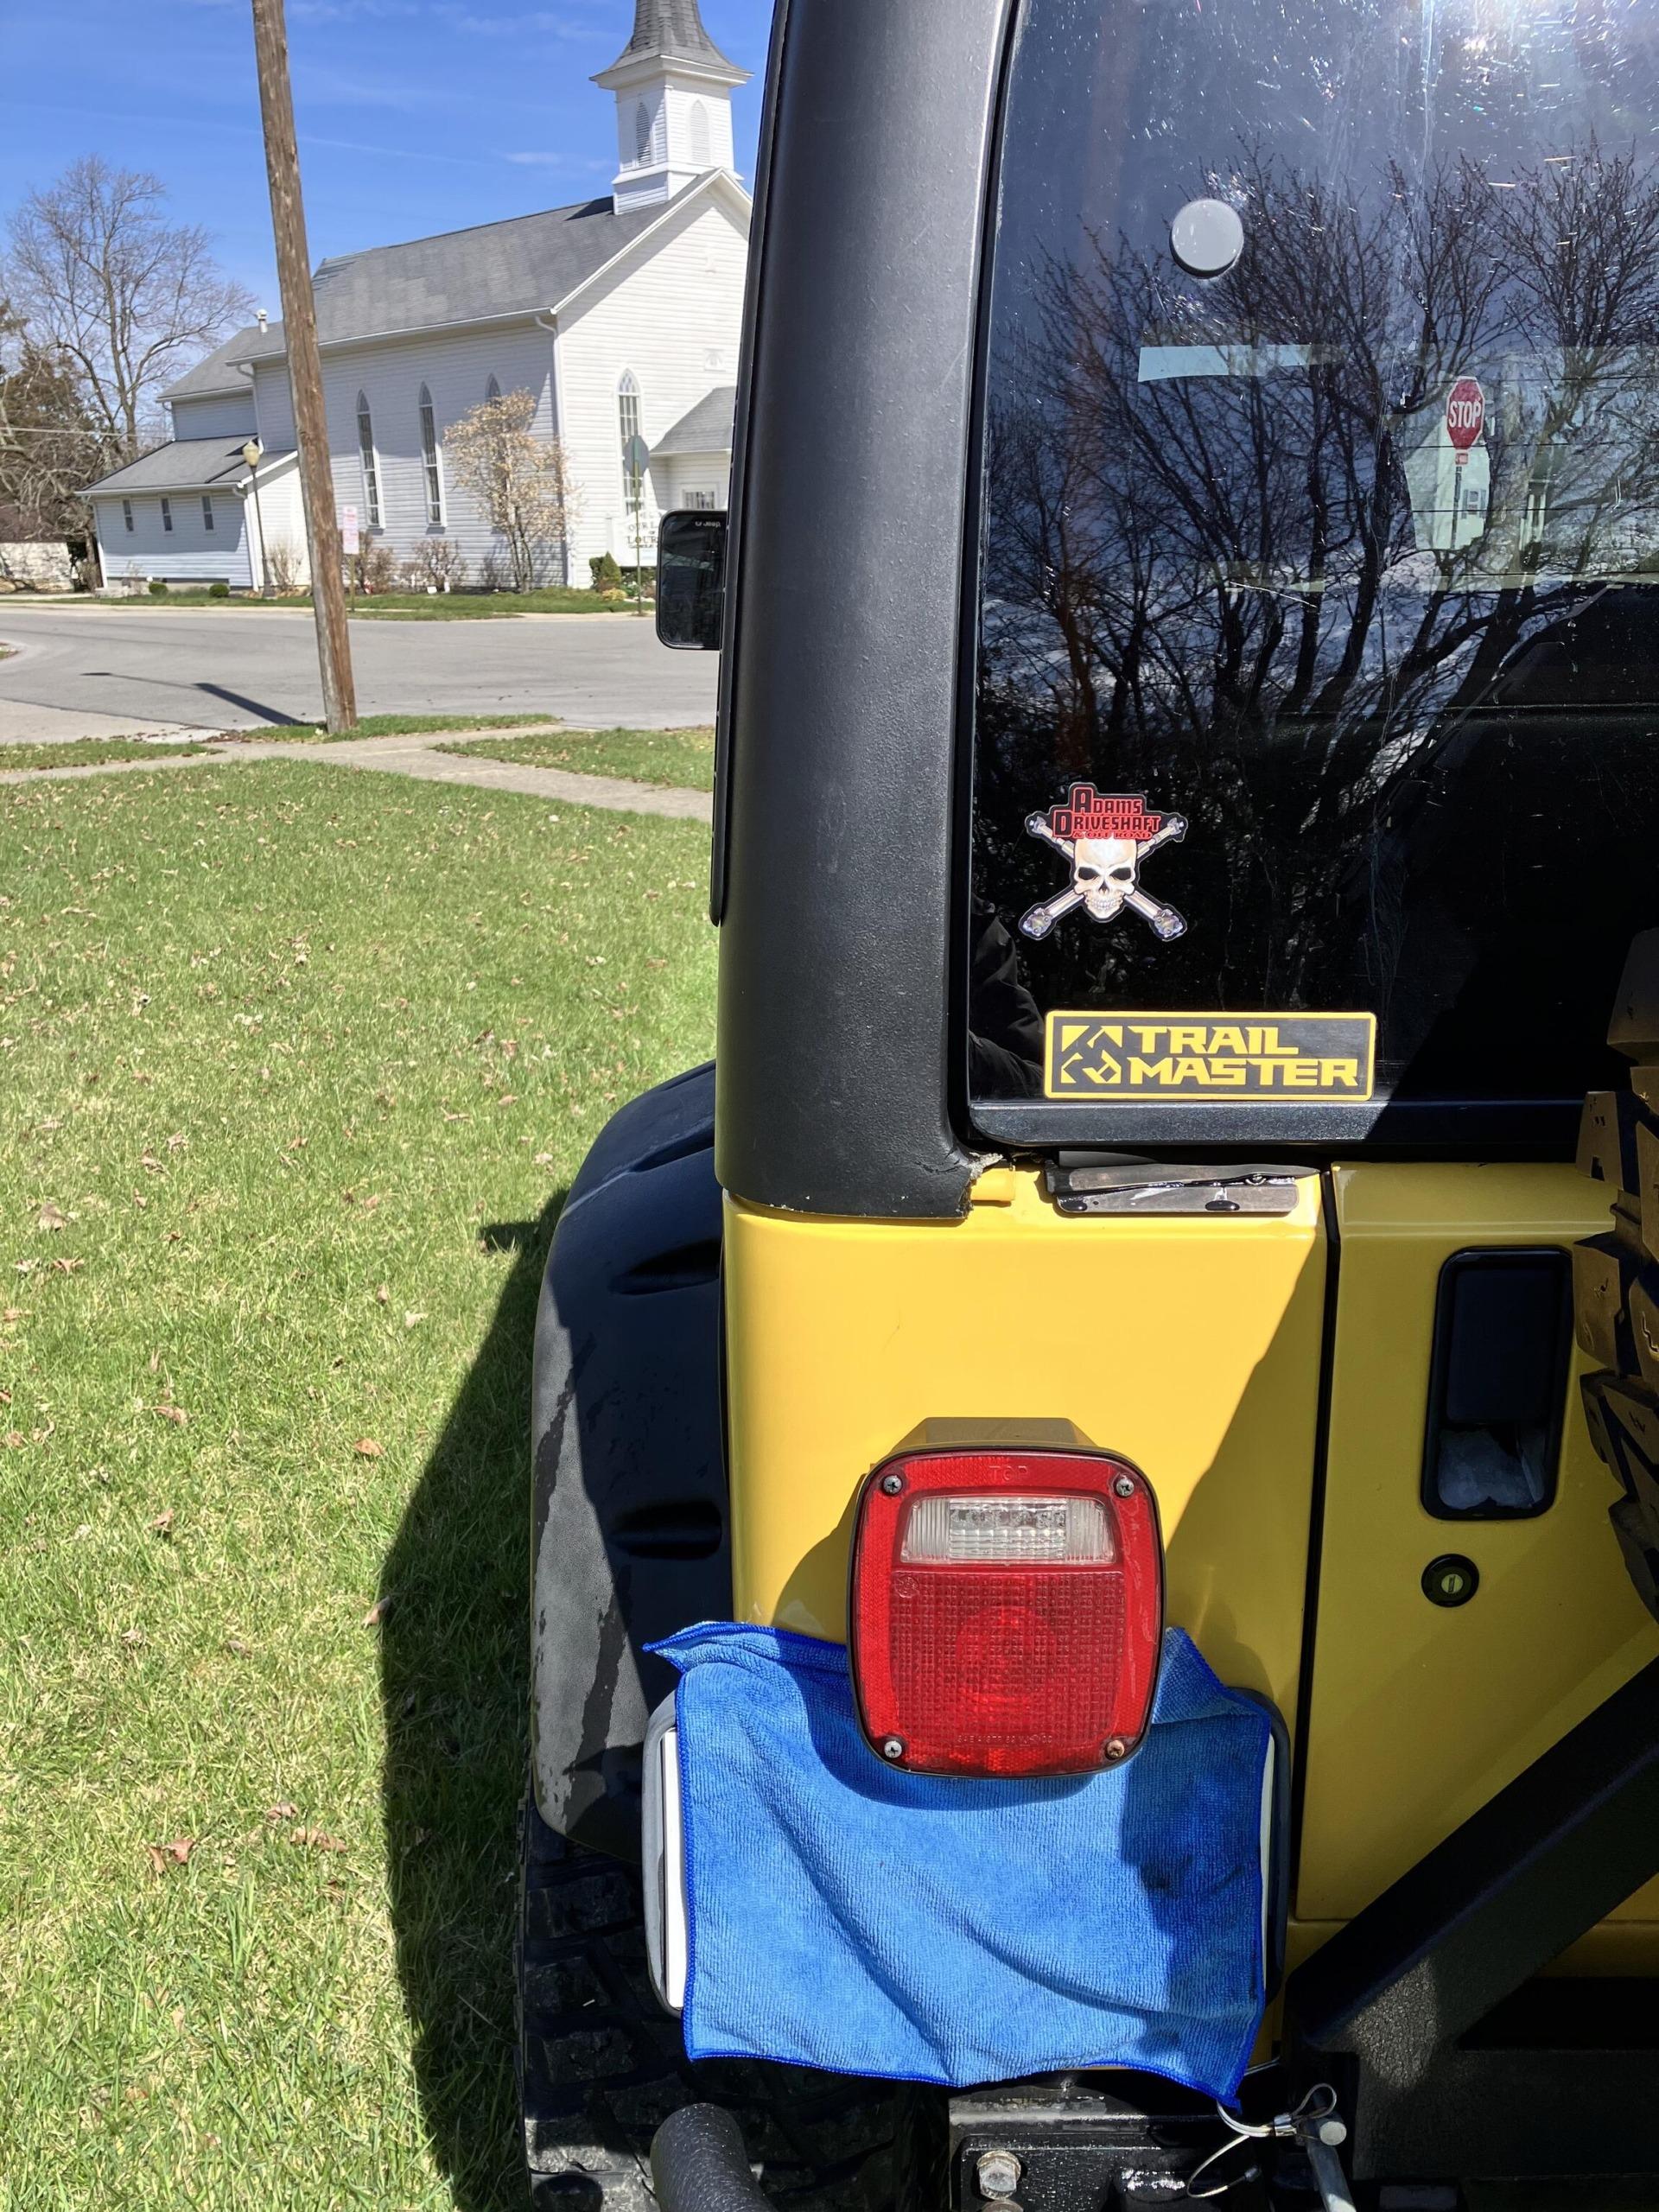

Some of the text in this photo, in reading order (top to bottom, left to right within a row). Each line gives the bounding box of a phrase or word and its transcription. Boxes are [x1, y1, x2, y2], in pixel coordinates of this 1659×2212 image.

[1448, 400, 1481, 428] STOP
[1073, 787, 1142, 815] ADAMS
[1052, 810, 1161, 837] DRIVESHAFT
[1128, 1026, 1299, 1054] TRAIL
[1128, 1058, 1359, 1087] MASTER
[988, 1465, 1028, 1482] TOP
